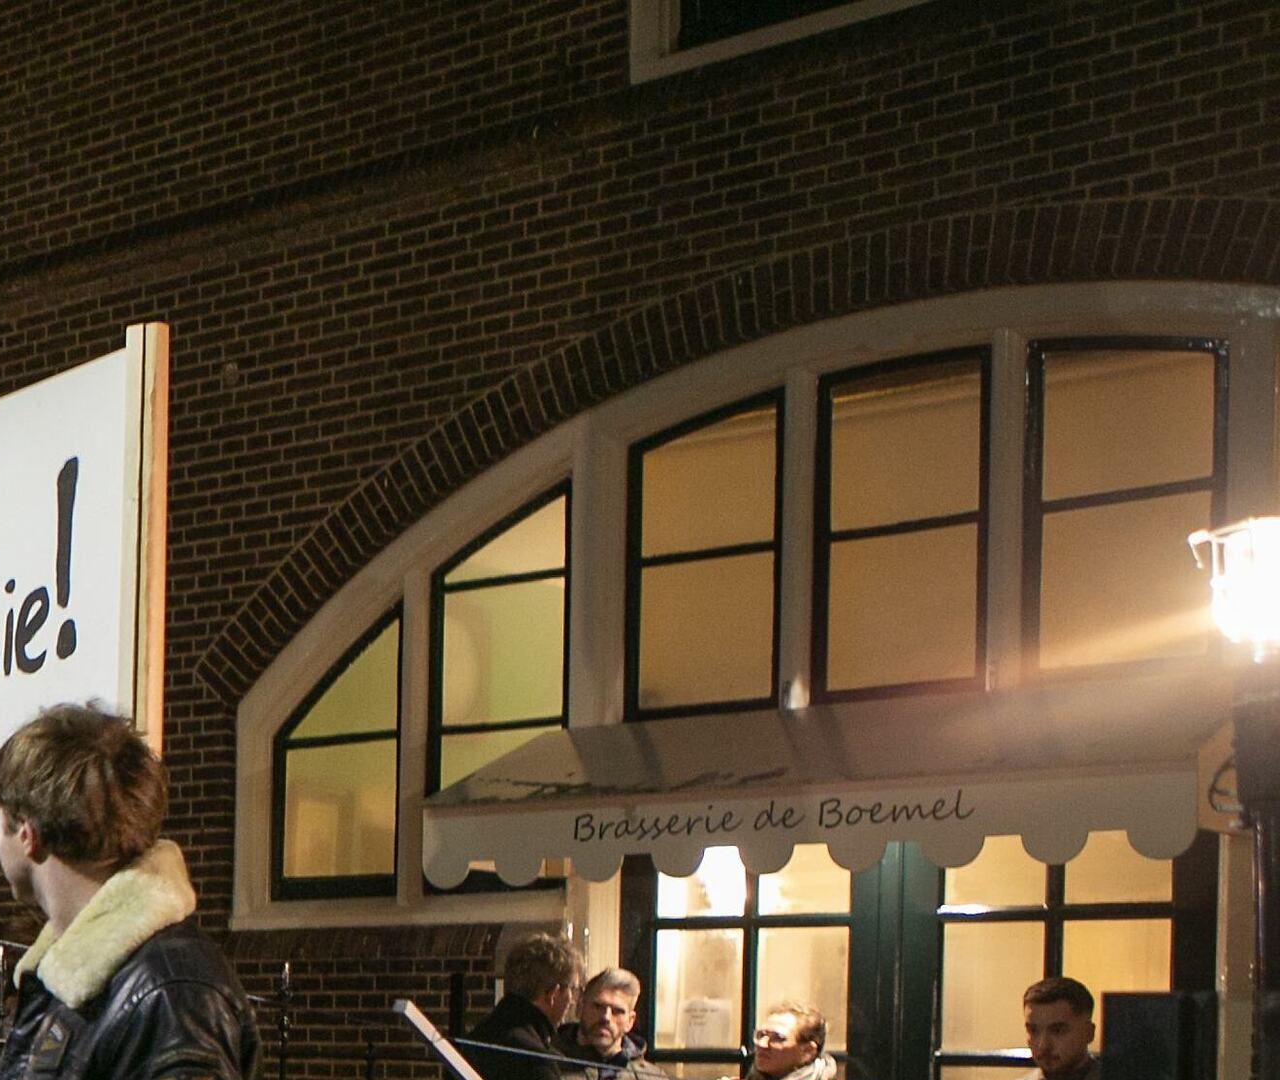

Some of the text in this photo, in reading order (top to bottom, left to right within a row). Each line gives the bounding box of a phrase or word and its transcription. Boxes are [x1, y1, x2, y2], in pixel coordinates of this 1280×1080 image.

[573, 790, 975, 842] Brasserie de Boemel
